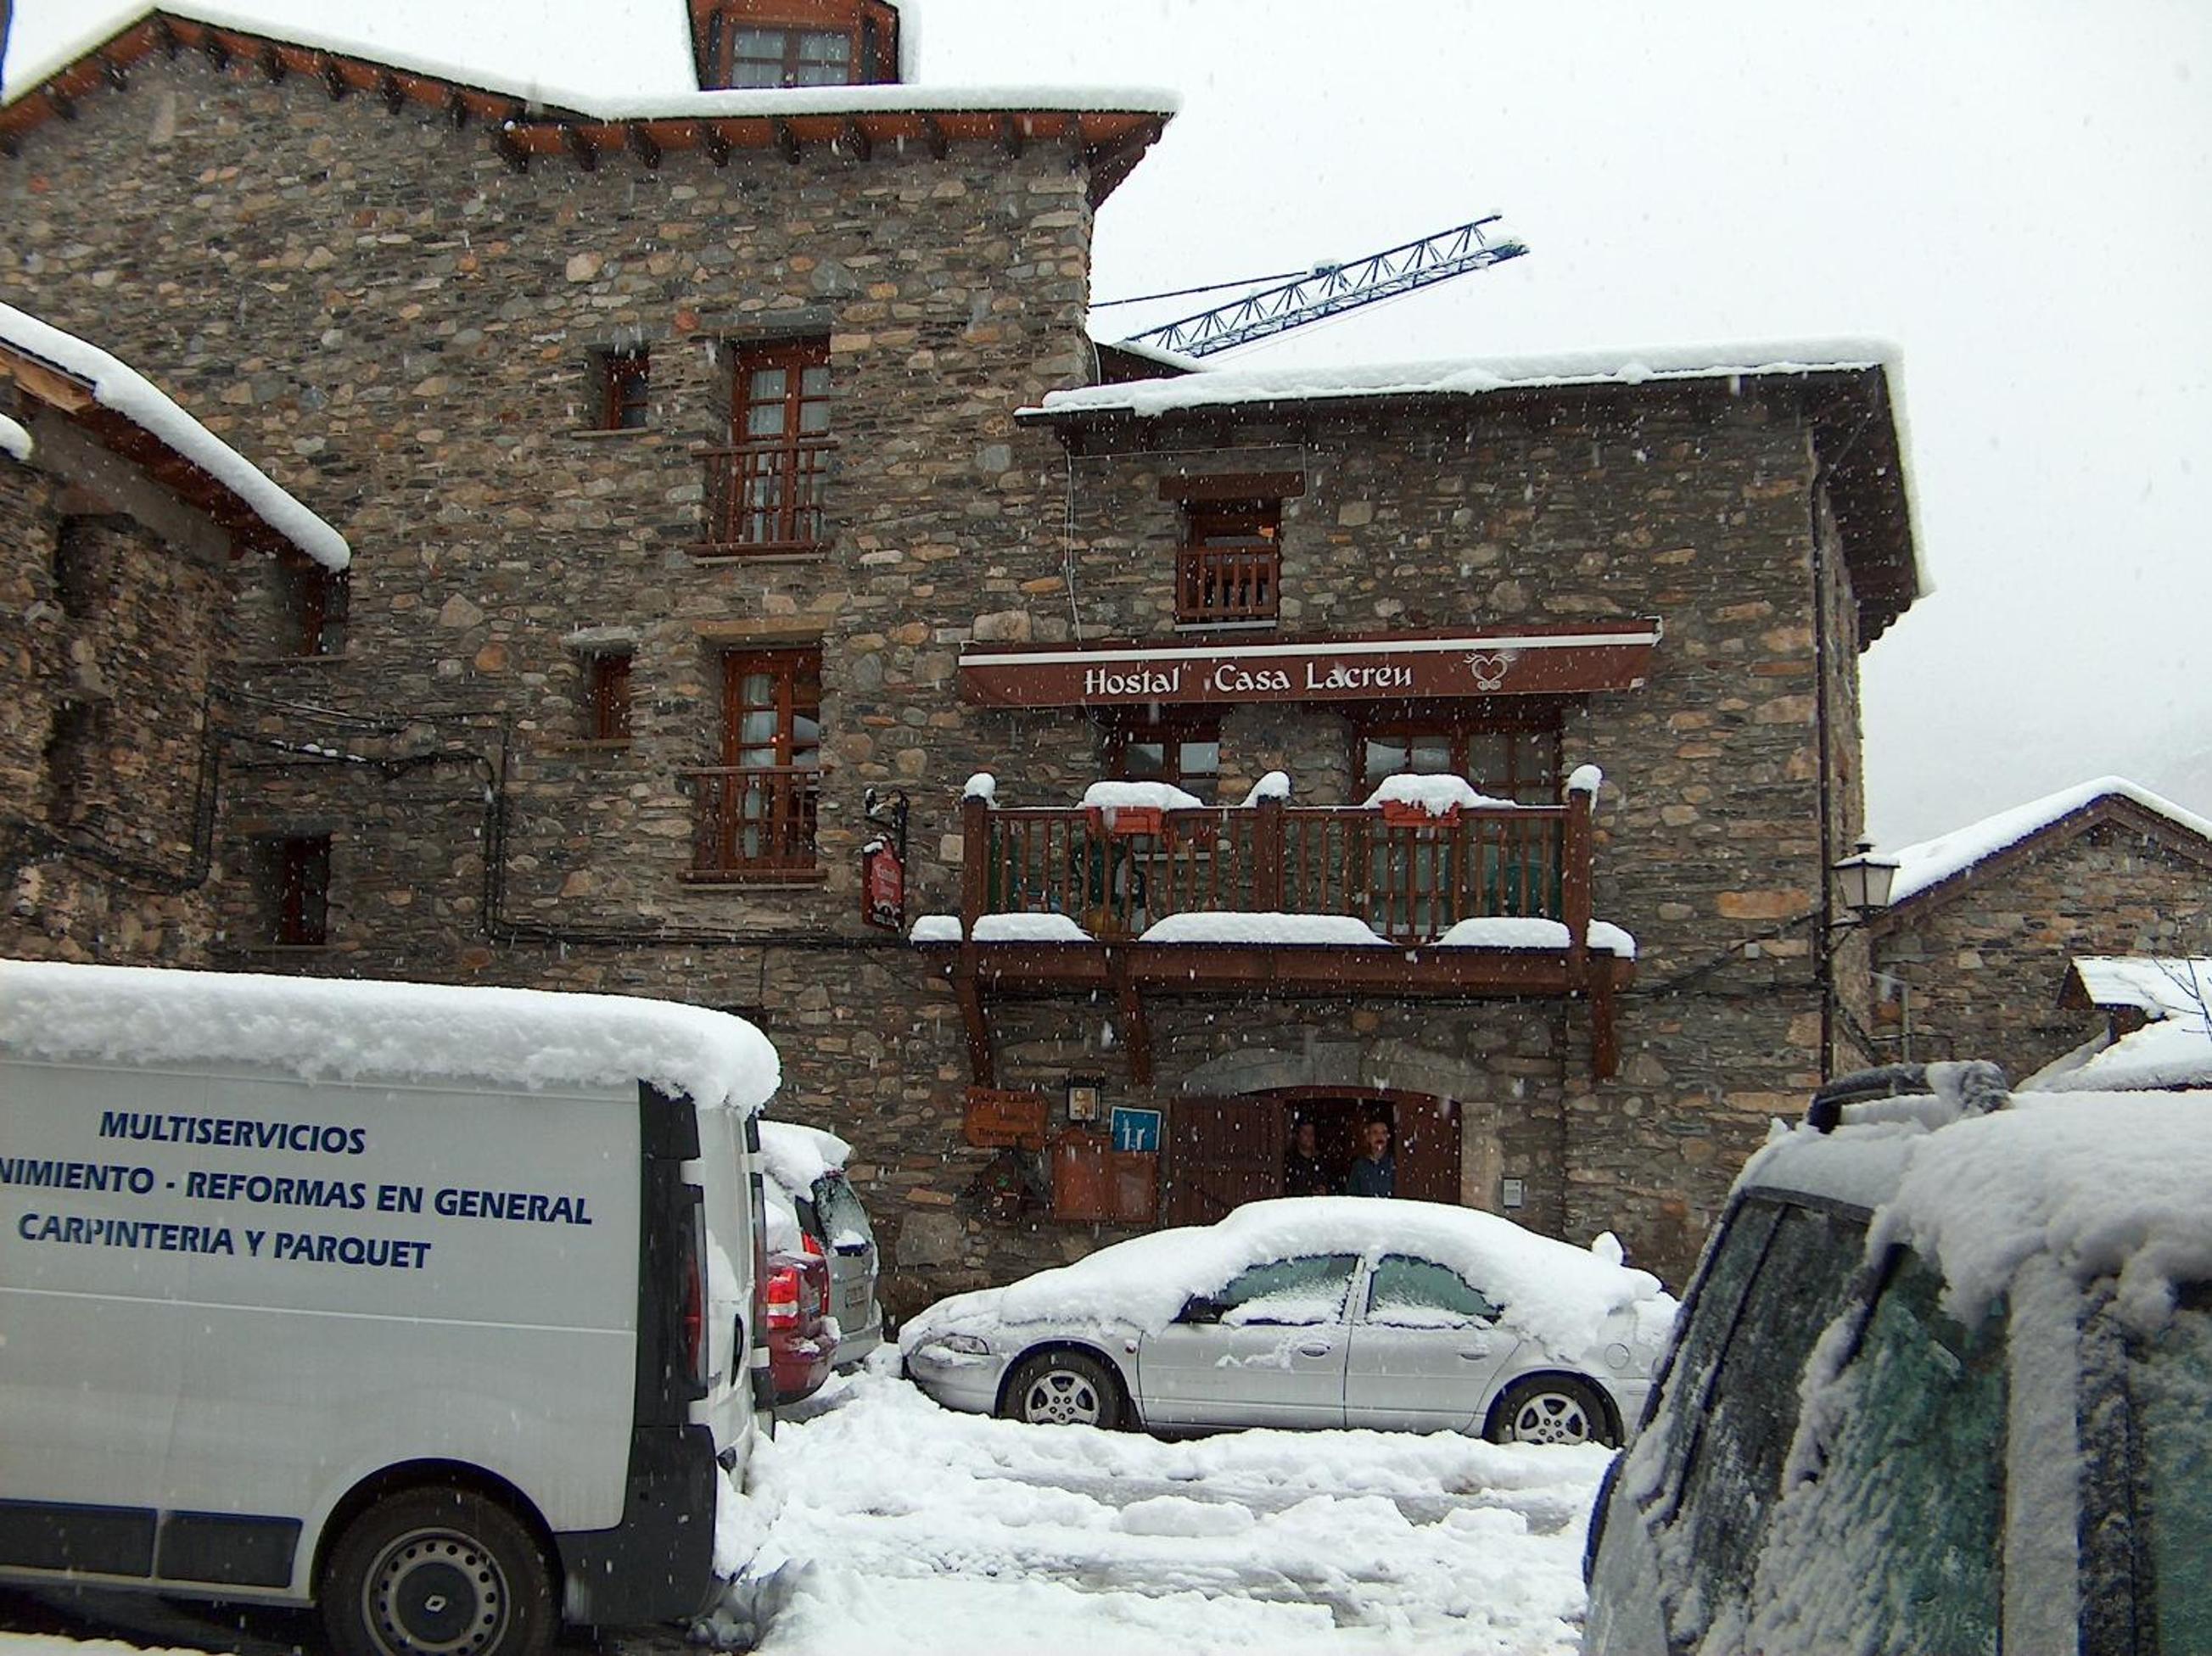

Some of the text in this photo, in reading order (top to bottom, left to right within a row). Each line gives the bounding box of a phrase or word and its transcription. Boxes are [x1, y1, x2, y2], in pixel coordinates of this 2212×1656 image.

[1084, 666, 1180, 696] Hostal
[1214, 664, 1291, 692] Casa
[98, 1111, 366, 1155] MULTISERVICIOS
[185, 1171, 367, 1211] REFORMAS
[376, 1184, 424, 1214] EN
[434, 1188, 593, 1225] GENERAL
[18, 1213, 432, 1269] CARPINTERIA Y PARQUET
